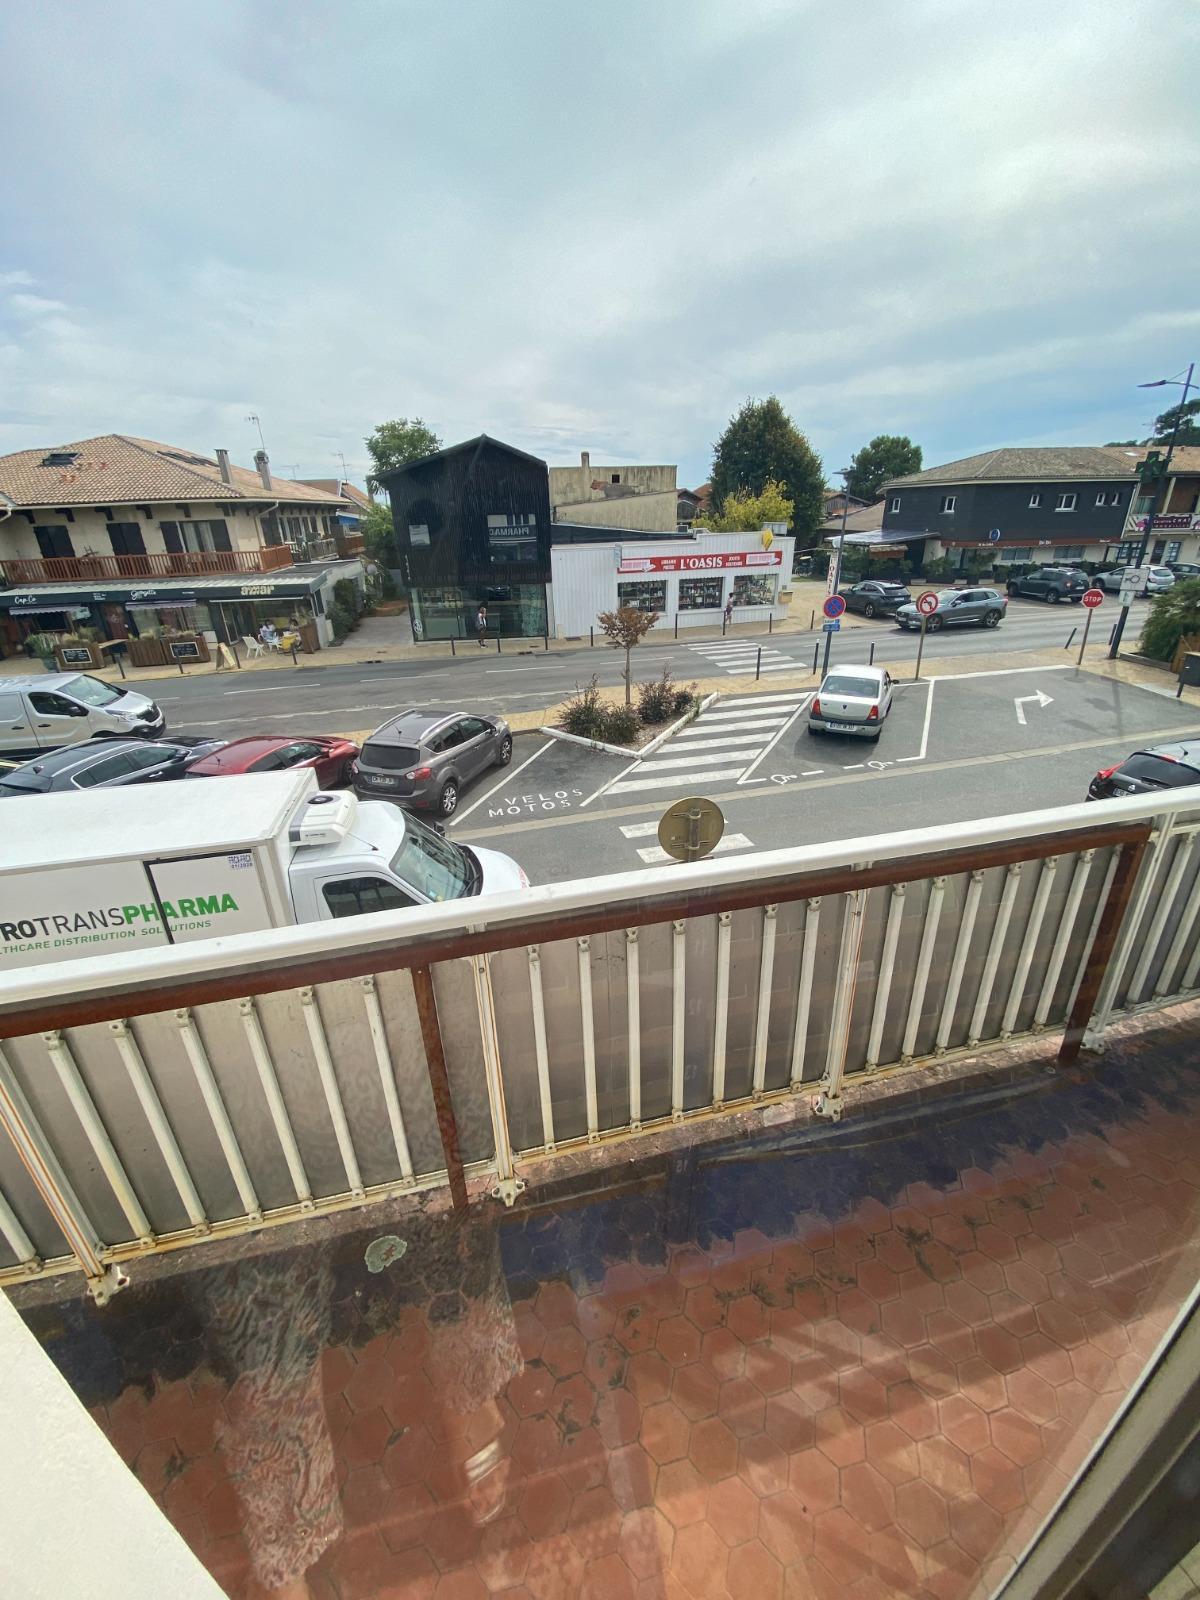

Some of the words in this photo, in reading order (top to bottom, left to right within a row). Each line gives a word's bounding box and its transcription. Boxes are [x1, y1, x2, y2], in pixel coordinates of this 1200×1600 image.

[680, 556, 723, 570] L'OASIS
[504, 788, 583, 806] VELOS
[488, 799, 571, 818] MOTOS
[53, 929, 136, 948] DISTRIBUTION
[141, 920, 212, 936] SOLUTIONS
